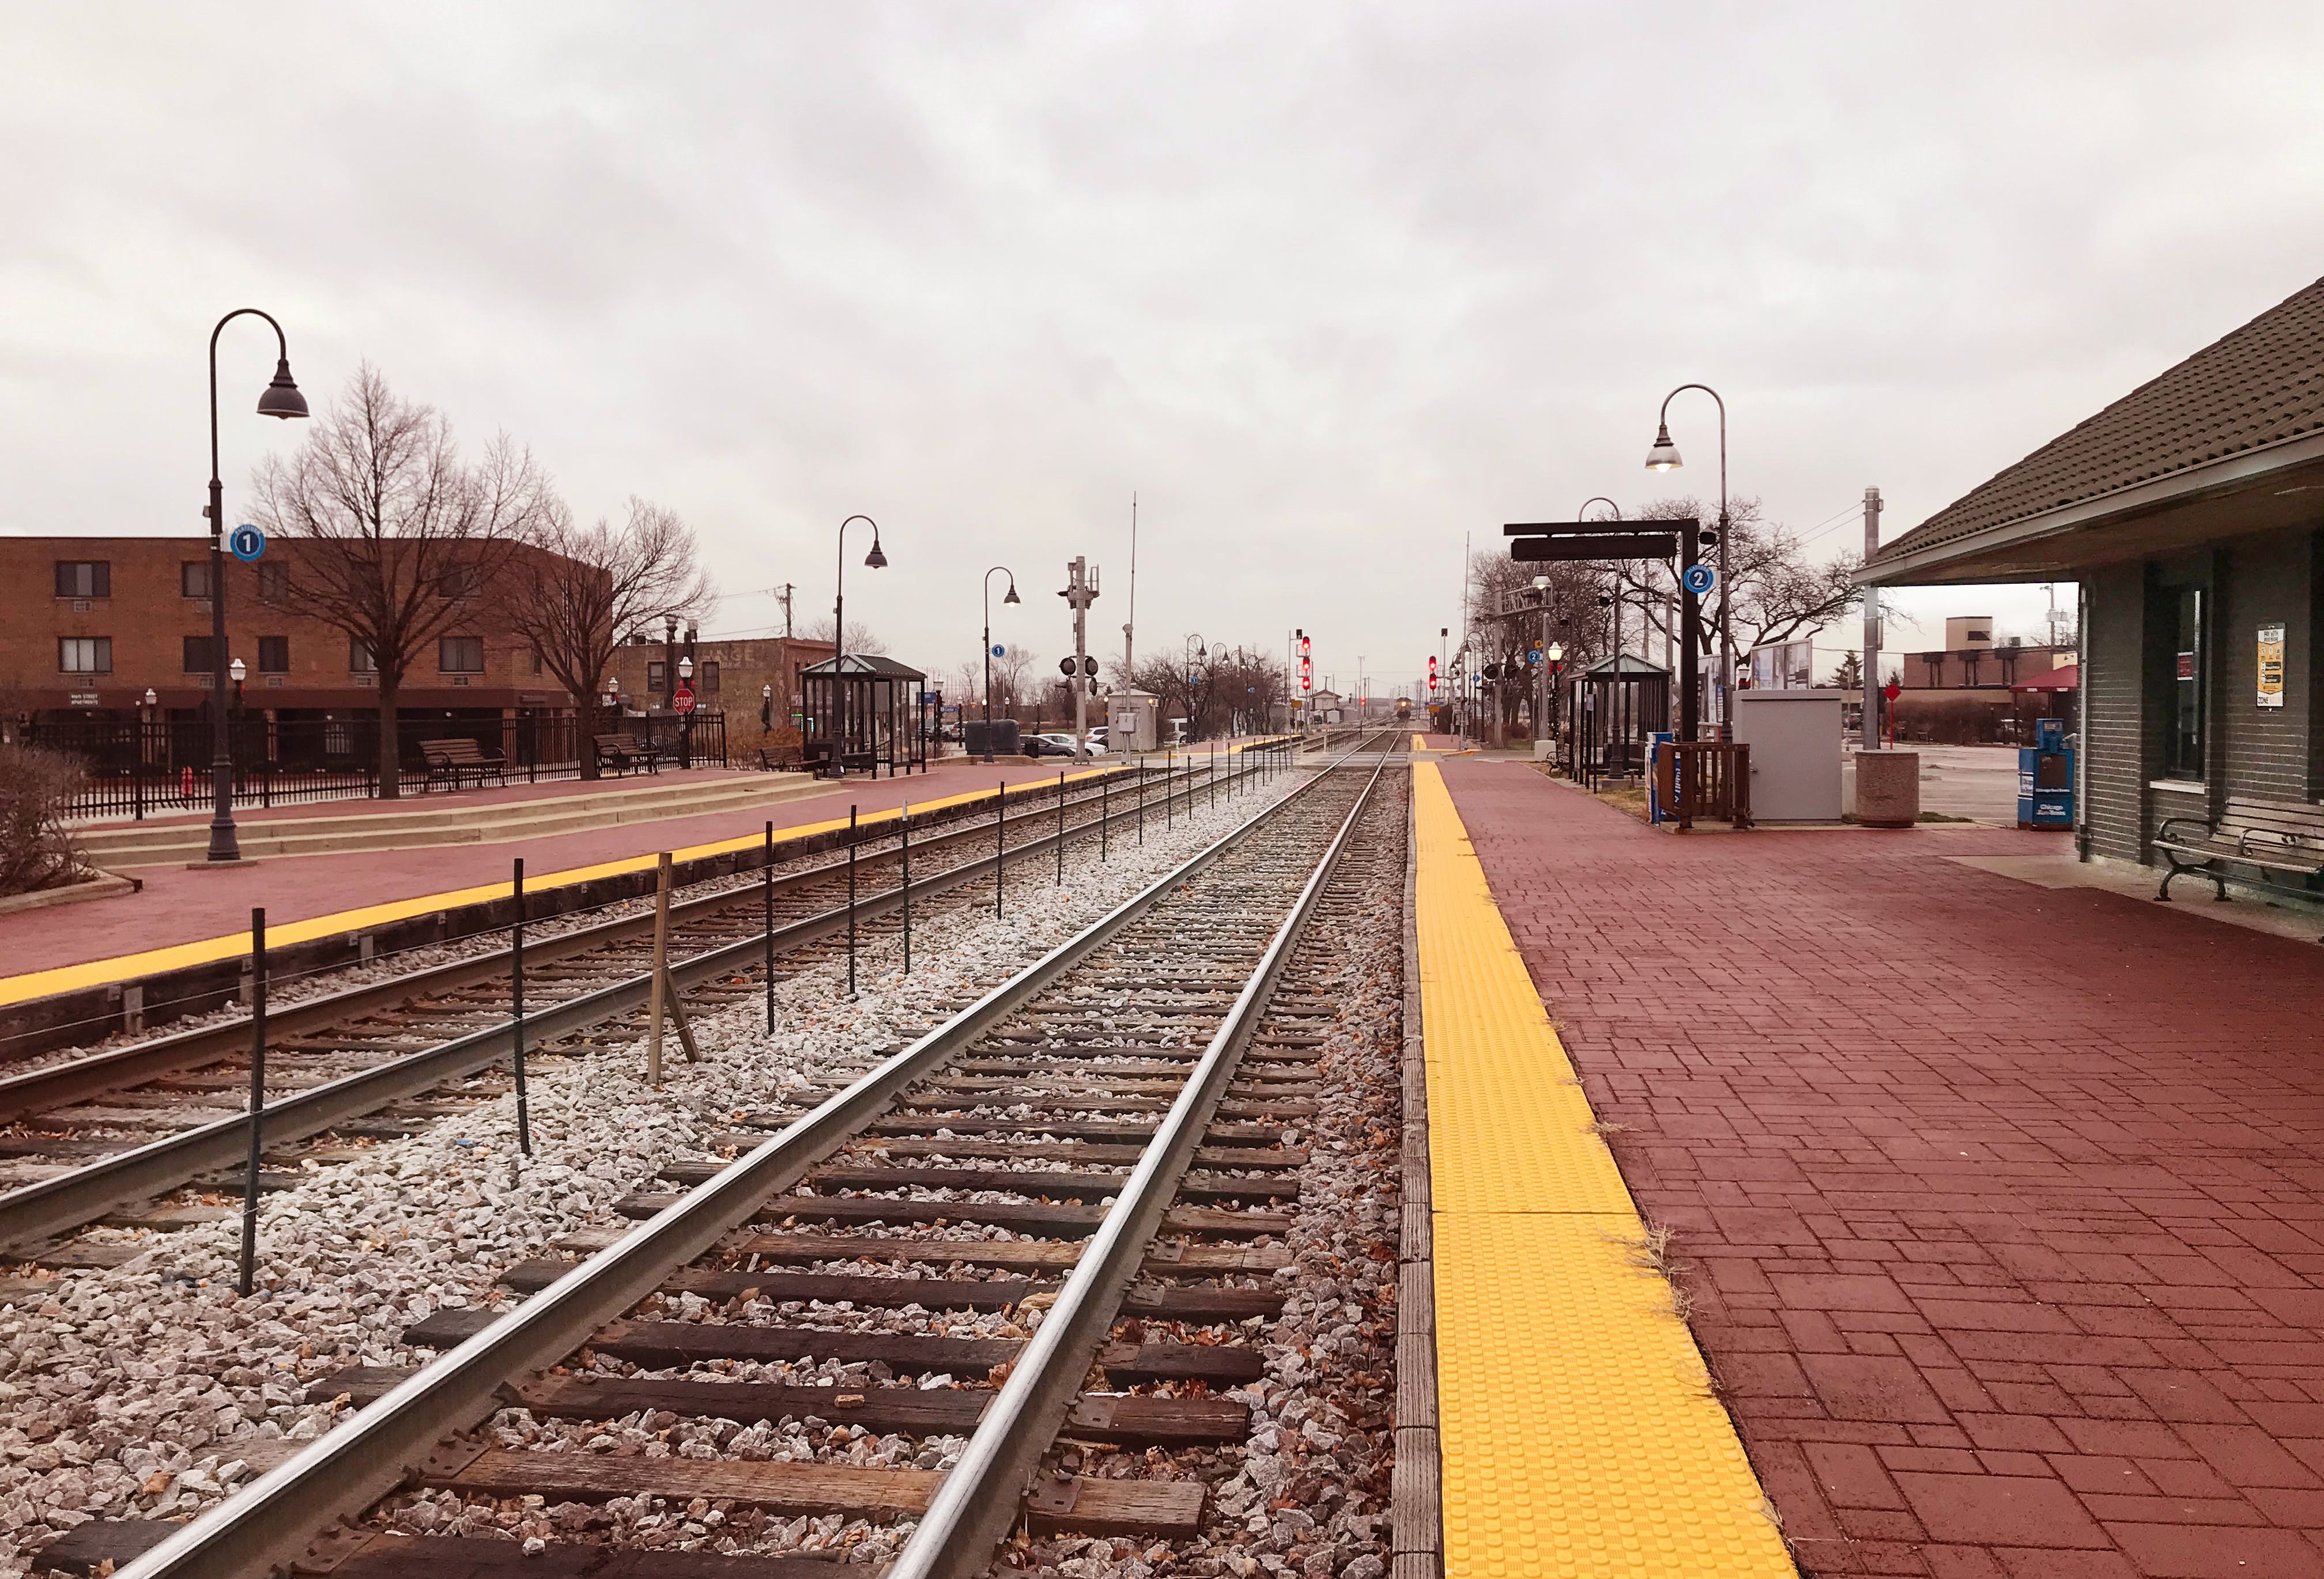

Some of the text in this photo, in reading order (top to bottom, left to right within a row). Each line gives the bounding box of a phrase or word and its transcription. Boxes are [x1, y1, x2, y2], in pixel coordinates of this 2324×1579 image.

[243, 534, 250, 552] 1
[1694, 572, 1704, 586] 2
[675, 697, 693, 707] STOP
